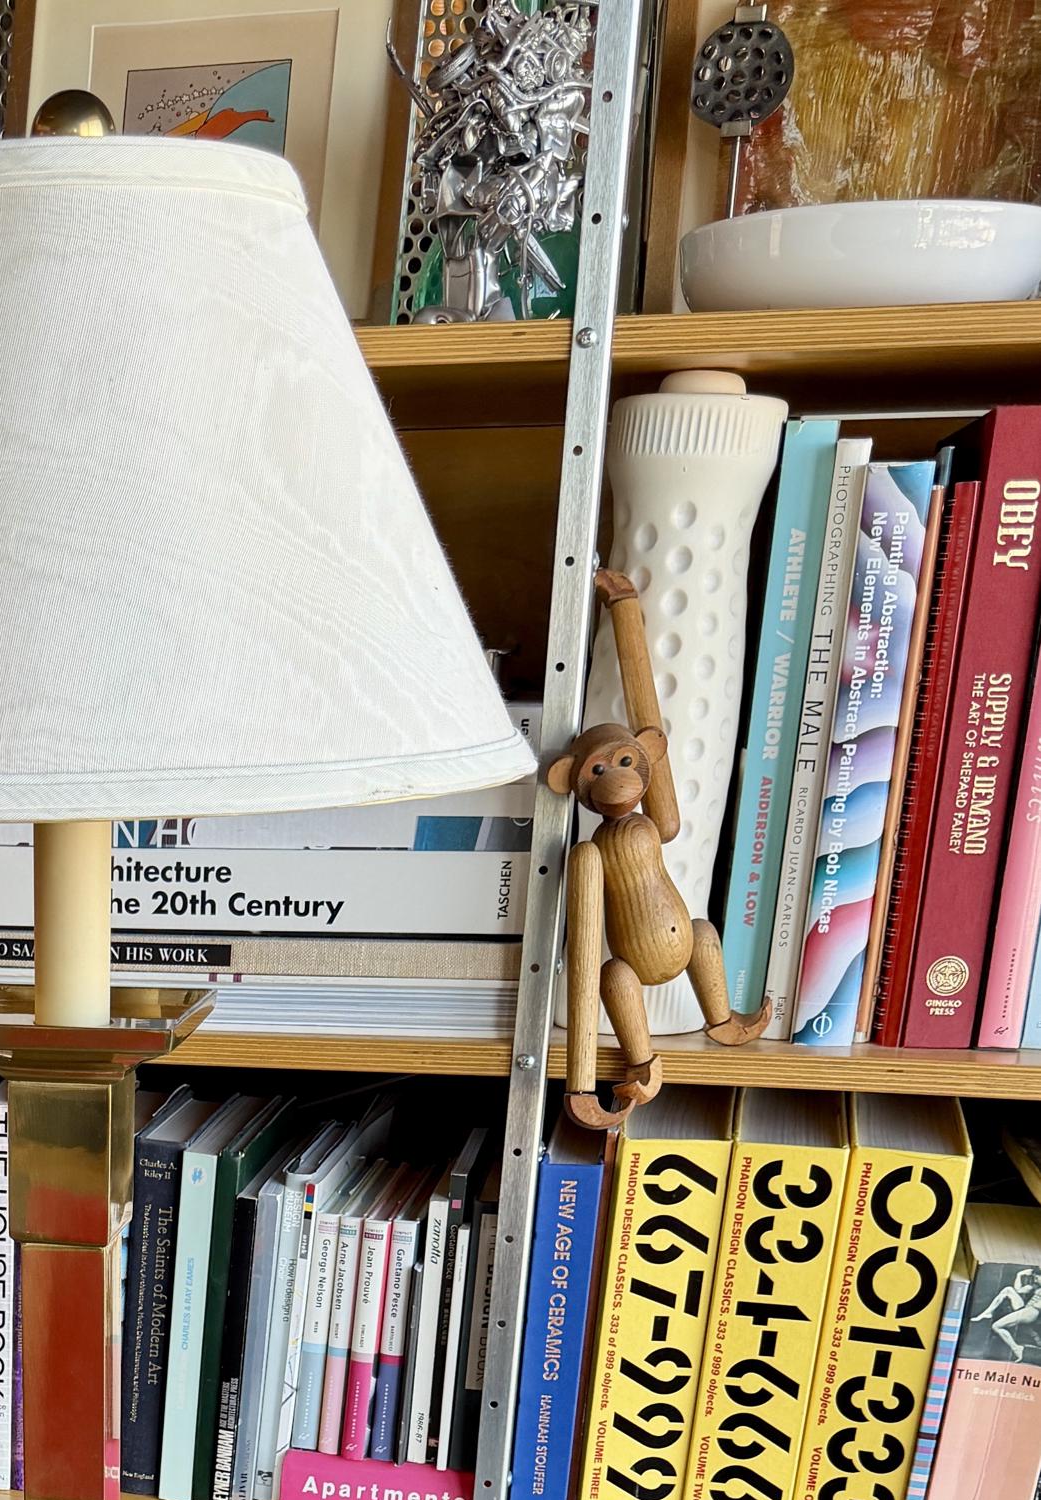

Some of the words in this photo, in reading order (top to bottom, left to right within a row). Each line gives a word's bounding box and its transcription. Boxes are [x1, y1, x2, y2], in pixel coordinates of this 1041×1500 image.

[821, 465, 851, 616] PHOTOGRAPHING
[869, 512, 888, 551] New
[993, 480, 1041, 570] OBEY
[883, 512, 910, 586] Painting
[780, 528, 806, 621] ATHLETE
[858, 558, 880, 640] Elements
[808, 629, 834, 684] THE
[854, 646, 870, 660] in
[870, 591, 898, 699] Abstraction:
[845, 666, 867, 744] Abstract
[971, 673, 986, 698] THE
[762, 655, 792, 760] WARRIOR
[968, 700, 982, 726] ART
[980, 673, 1012, 749] SUPPLY
[797, 700, 823, 774] MALE
[964, 729, 978, 749] OF
[831, 744, 857, 813] Painting
[955, 752, 975, 808] SHEPARD
[793, 787, 808, 845] RICARDO
[829, 818, 847, 837] by
[948, 811, 965, 855] FAIREY
[963, 775, 998, 856] DEMAND
[111, 856, 232, 883] hitecture
[825, 843, 844, 875] Bob
[111, 888, 141, 914] he
[152, 890, 217, 915] 20th
[228, 892, 345, 925] Century
[497, 859, 513, 920] TASCHEN
[779, 851, 800, 948] JUAN-CARLOS
[818, 880, 838, 934] Nickas
[126, 946, 153, 961] HIS
[159, 948, 209, 962] WORK
[925, 999, 962, 1009] GINGKO
[929, 1008, 956, 1017] PRESS
[626, 1152, 640, 1204] PHAIDON
[157, 1206, 174, 1234] The
[561, 1179, 578, 1221] NEW
[555, 1223, 573, 1263] AGE
[619, 1208, 633, 1250] DESIGN
[154, 1238, 171, 1280] Saints
[318, 1239, 331, 1273] George
[339, 1241, 349, 1265] Arne
[366, 1246, 376, 1268] Jean
[393, 1248, 405, 1290] Gaetano
[152, 1284, 168, 1300] of
[315, 1275, 327, 1308] Nelson
[335, 1267, 348, 1310] Jacobsen
[363, 1271, 374, 1304] Prouvé
[552, 1265, 569, 1289] OF
[612, 1254, 628, 1311] CLASSICS.
[390, 1291, 401, 1319] Pesce
[609, 1314, 620, 1334] 333
[149, 1301, 167, 1358] Modern
[543, 1292, 569, 1382] CERAMICS
[608, 1336, 617, 1348] of
[147, 1361, 163, 1385] Art
[606, 1350, 616, 1369] 999
[956, 1368, 980, 1380] The
[984, 1371, 1017, 1384] Male
[1022, 1375, 1041, 1387] Nu
[600, 1372, 612, 1410] objects.
[537, 1395, 552, 1442] HANNAH
[216, 1429, 235, 1469] BANHAM
[593, 1420, 607, 1463] VOLUME
[532, 1444, 548, 1496] STOUFFER
[590, 1466, 602, 1499] THREE
